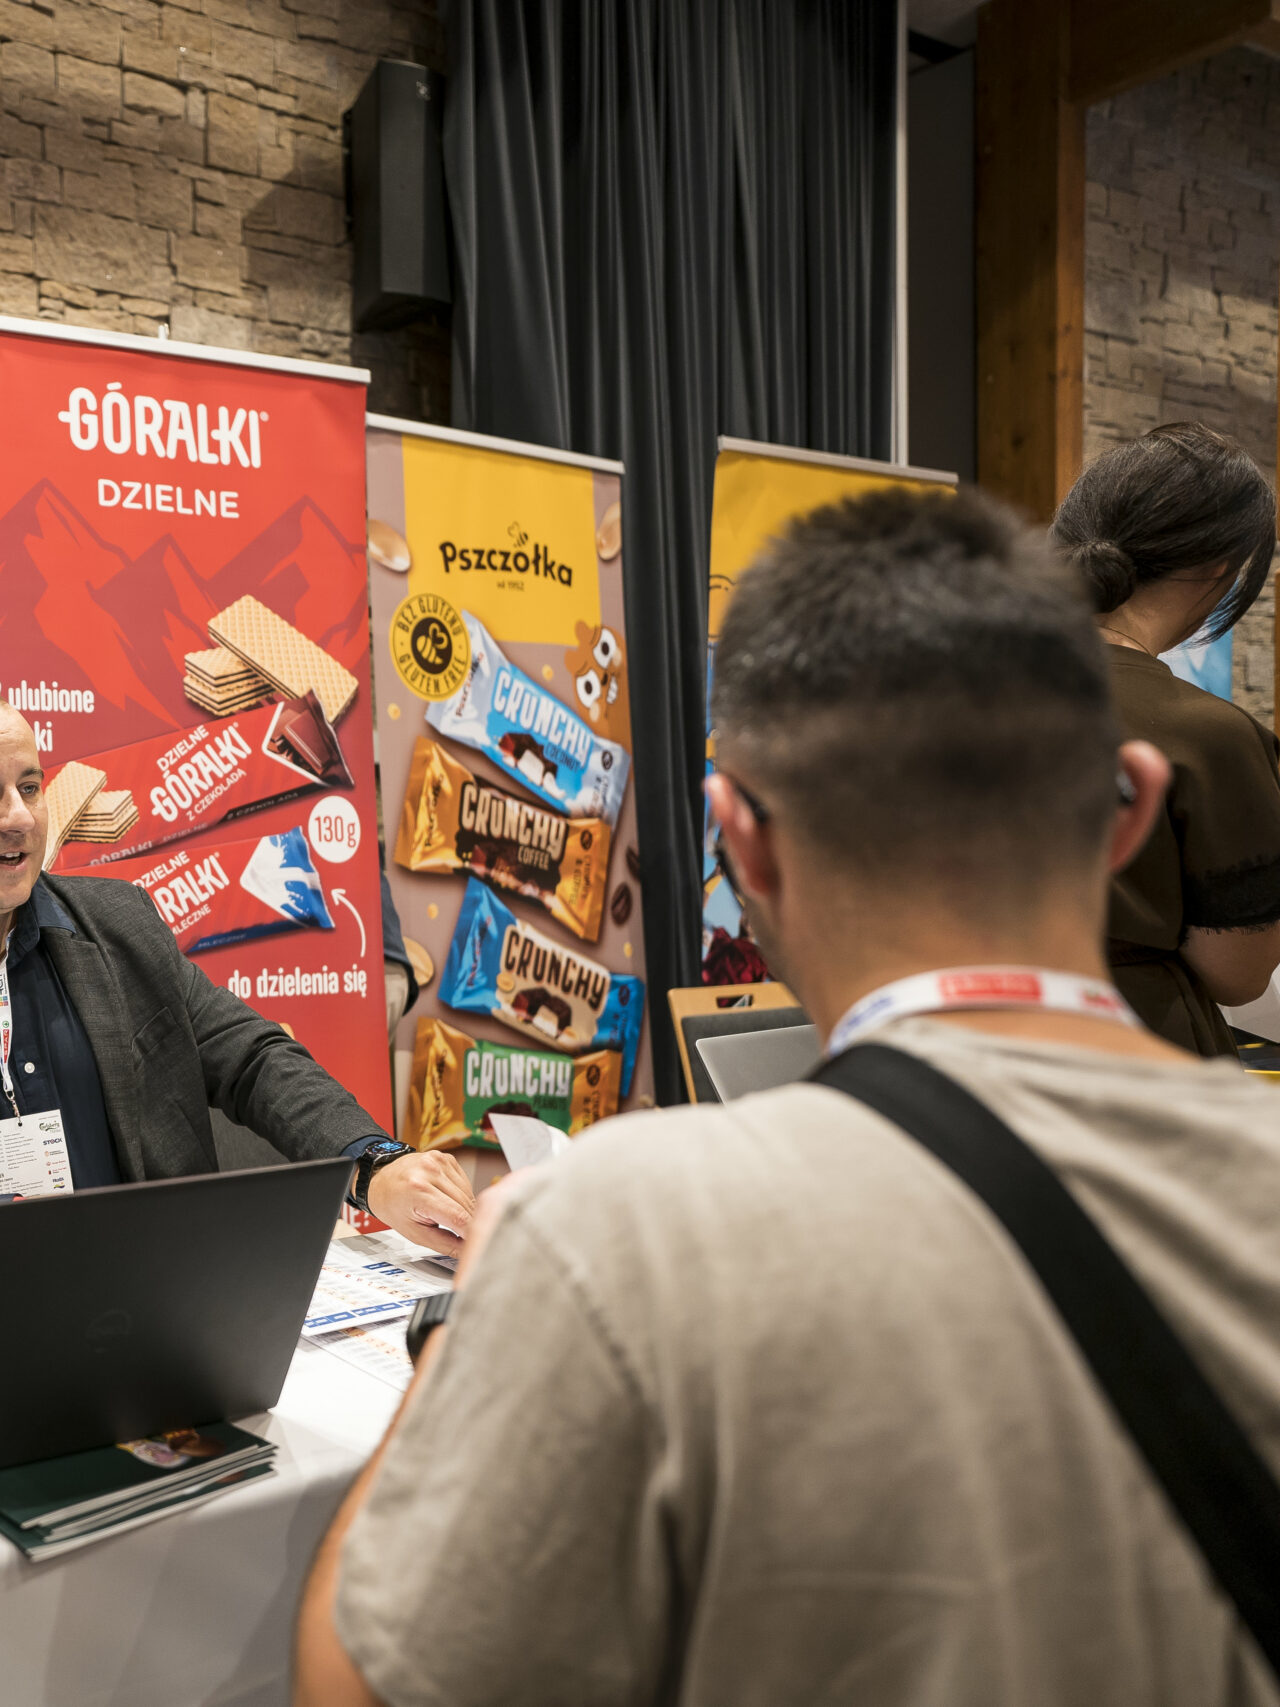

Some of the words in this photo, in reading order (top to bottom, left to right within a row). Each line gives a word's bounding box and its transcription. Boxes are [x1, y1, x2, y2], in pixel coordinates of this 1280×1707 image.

[98, 478, 240, 519] DZIELNE
[8, 680, 95, 714] ulubione
[156, 725, 210, 772] DZIELNE
[186, 810, 196, 822] Z
[517, 845, 550, 871] COFFEE
[228, 969, 251, 999] do
[256, 966, 339, 998] dzielenia
[343, 963, 367, 998] się
